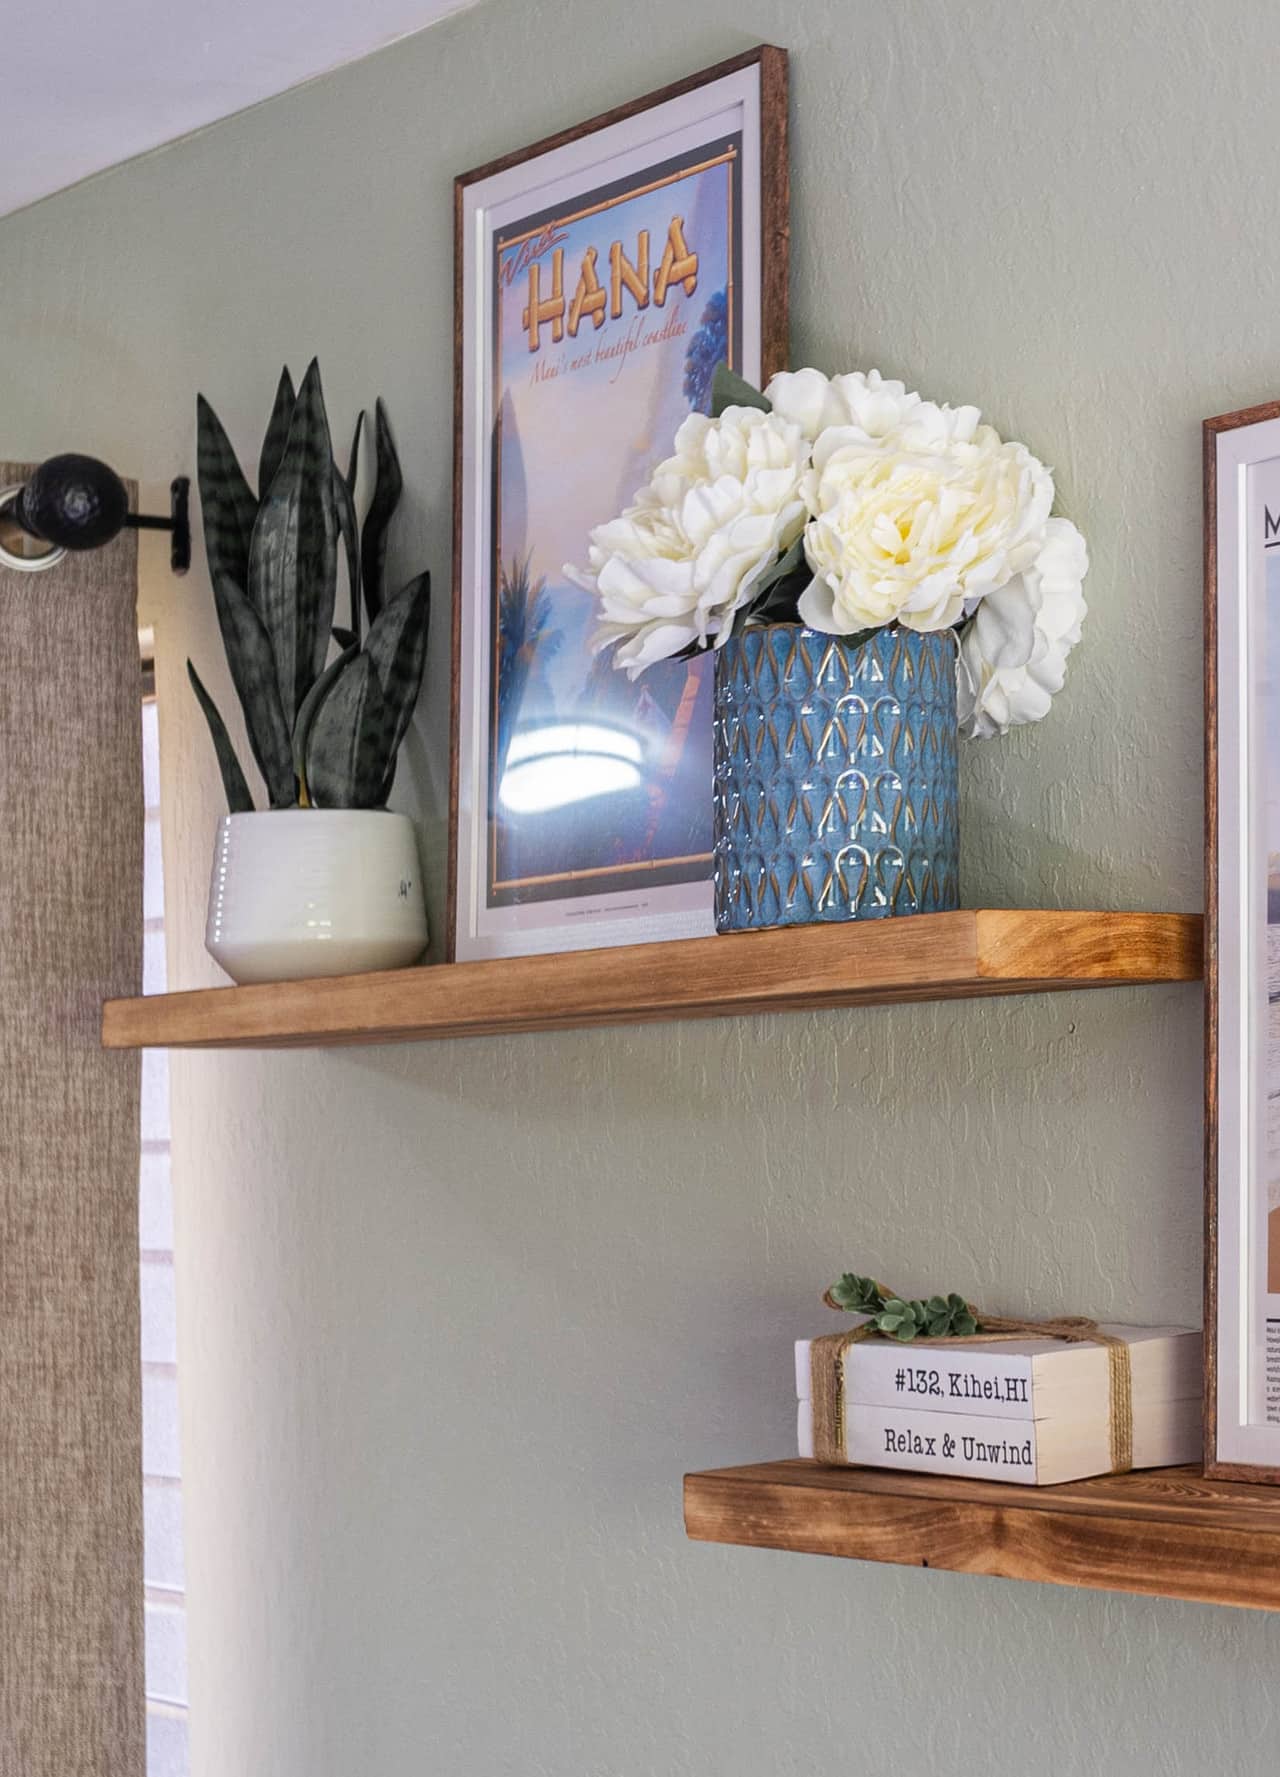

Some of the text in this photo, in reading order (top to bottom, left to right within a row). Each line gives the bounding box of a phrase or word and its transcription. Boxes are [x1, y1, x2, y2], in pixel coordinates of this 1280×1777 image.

[522, 215, 699, 353] HANA
[530, 304, 688, 388] Maui's most beautiful coastline
[895, 1368, 944, 1397] #132,
[884, 1428, 1033, 1465] Relax & Unwind
